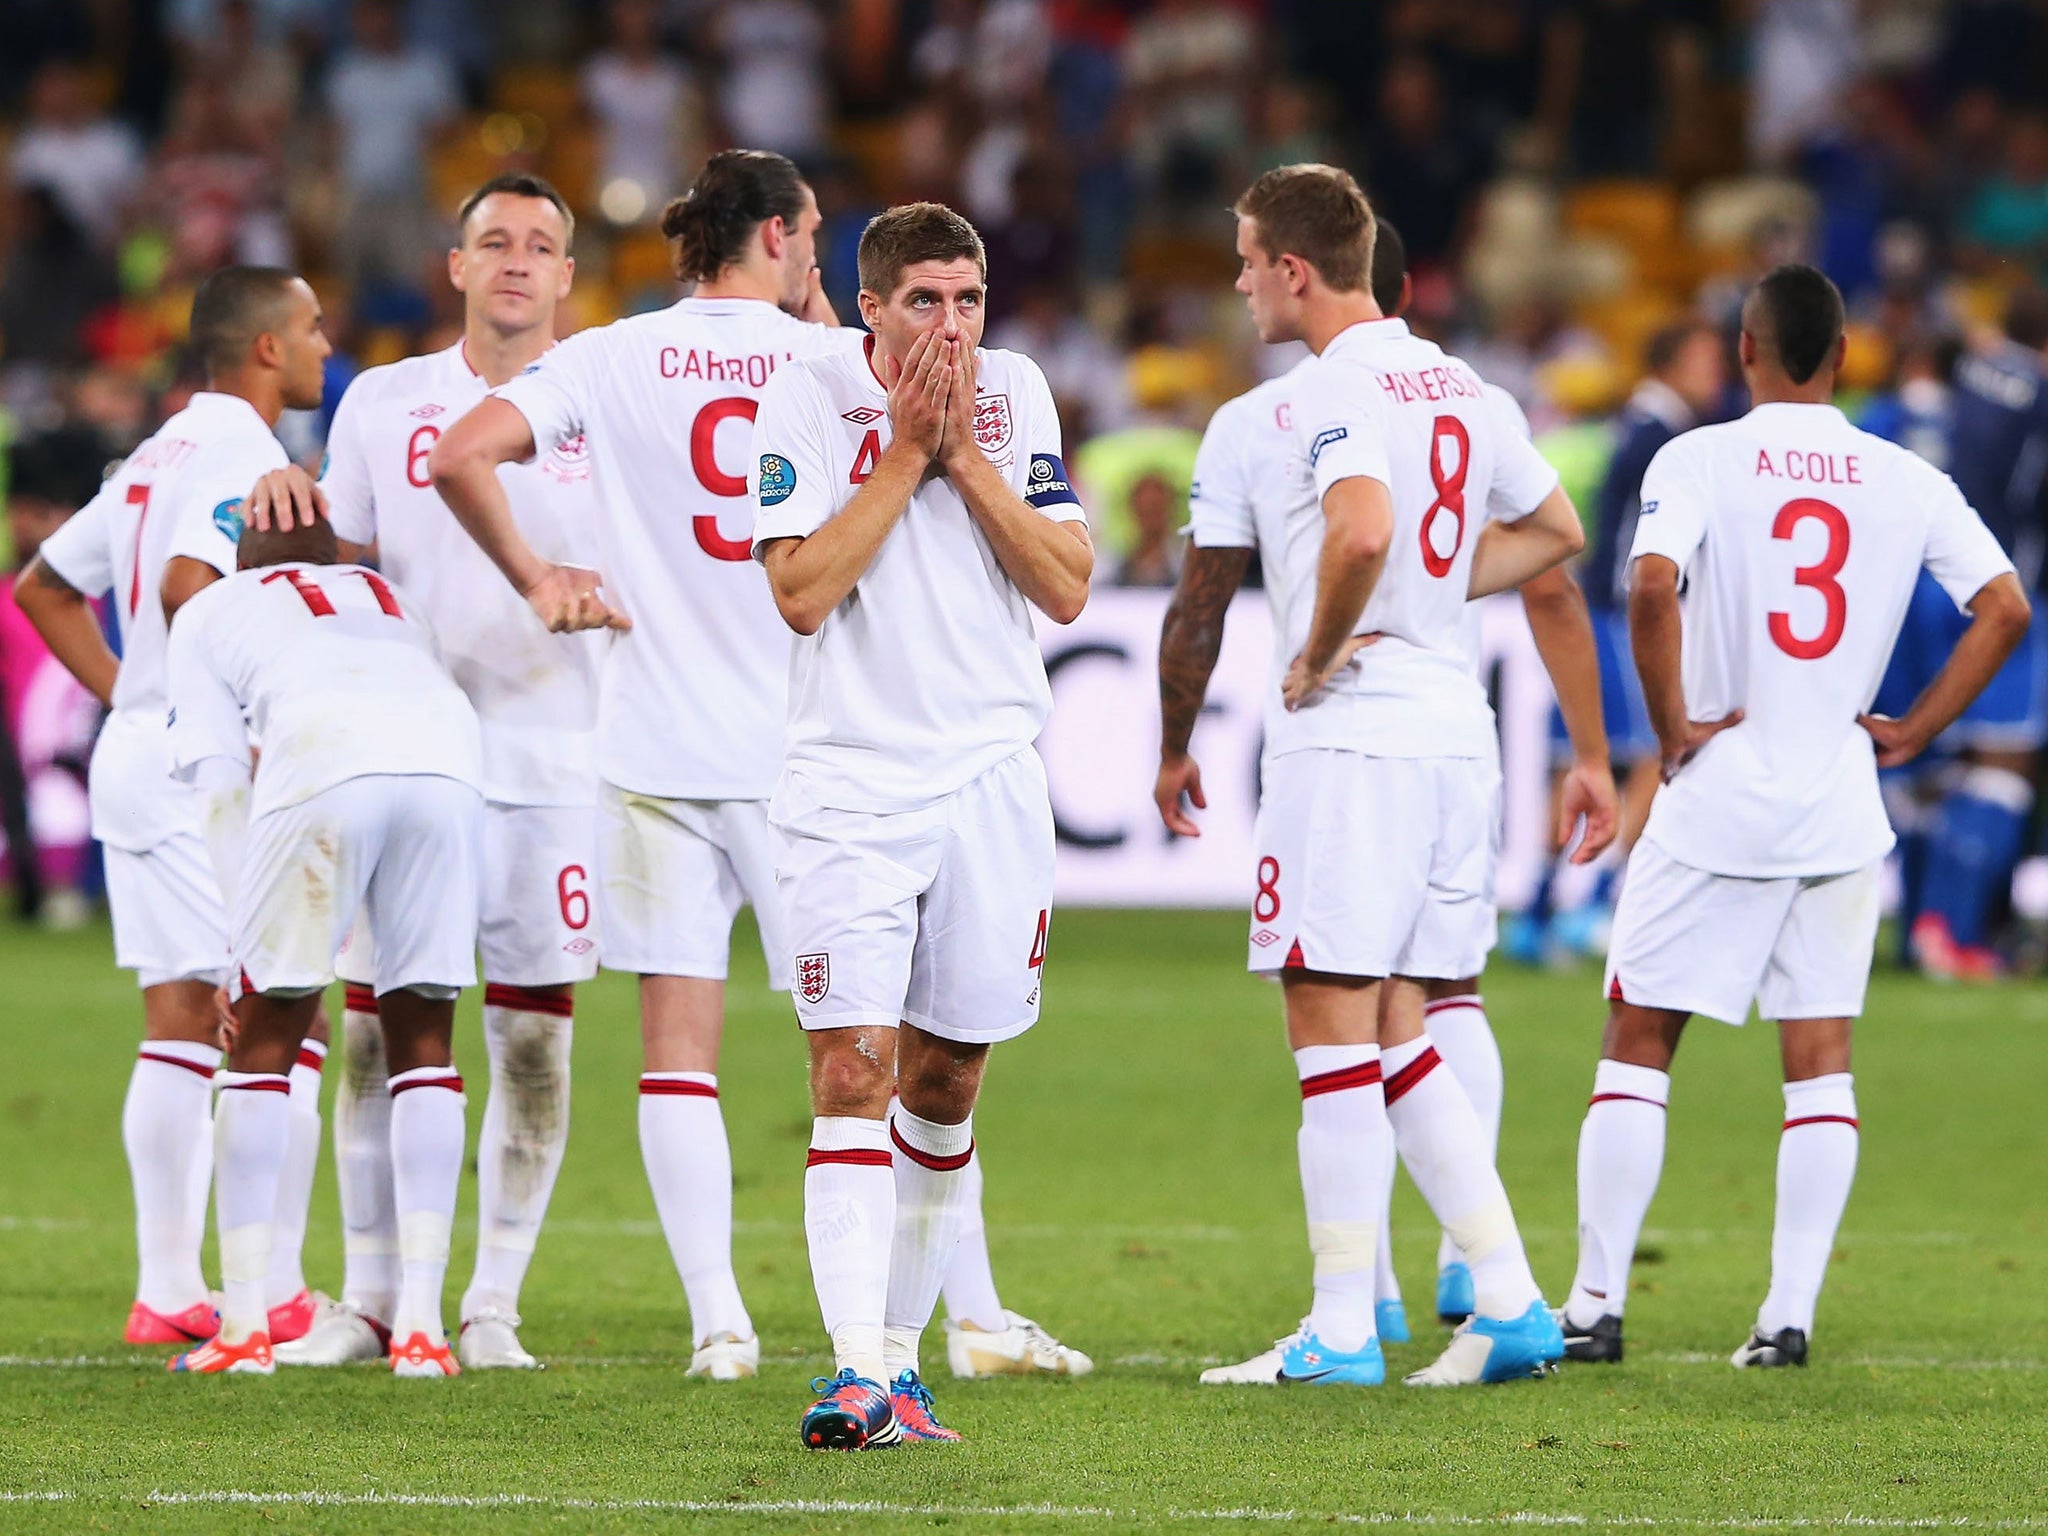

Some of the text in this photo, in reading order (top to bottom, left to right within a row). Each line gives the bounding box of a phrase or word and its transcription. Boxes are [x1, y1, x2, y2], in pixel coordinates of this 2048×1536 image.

[659, 346, 794, 389] CARROL
[406, 424, 441, 489] 6
[690, 396, 762, 562] 9
[849, 429, 883, 486] 4
[1024, 481, 1070, 497] ESPECT
[1756, 449, 1863, 485] A.COLE
[1419, 415, 1472, 579] 8
[126, 484, 151, 618] 7
[1767, 497, 1852, 661] 3
[260, 569, 405, 620] 11
[557, 864, 590, 930] 6
[1254, 856, 1281, 924] 8
[1028, 908, 1047, 980] 4
